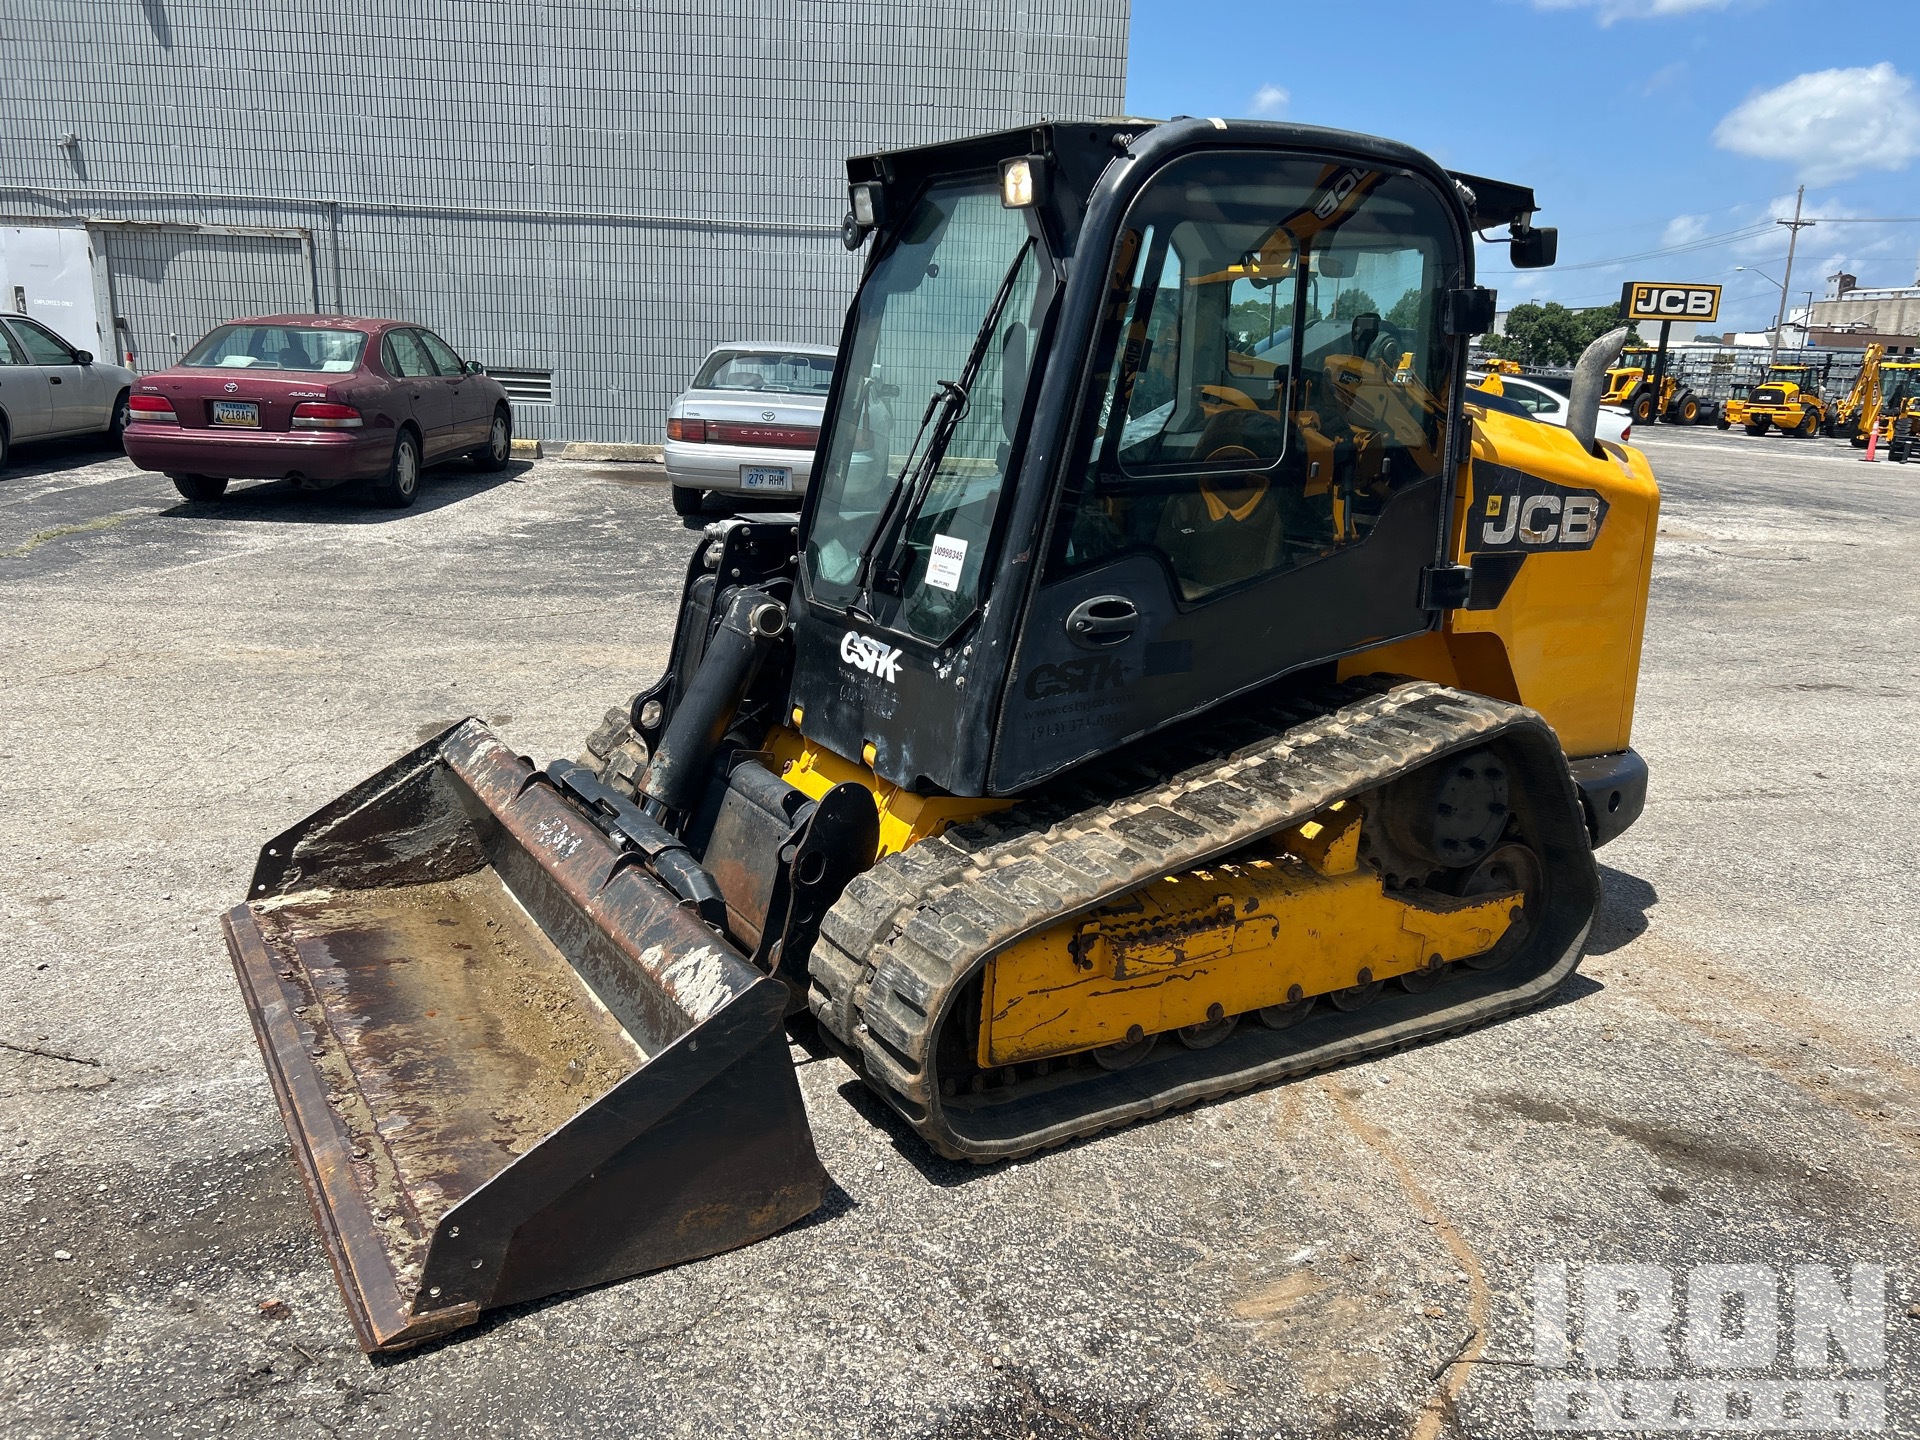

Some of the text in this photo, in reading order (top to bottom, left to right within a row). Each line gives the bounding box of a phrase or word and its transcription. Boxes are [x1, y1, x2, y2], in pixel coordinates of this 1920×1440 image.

[33, 298, 60, 306] EMPLOYEES
[1636, 289, 1713, 314] JCB
[220, 408, 256, 421] 7218AFW
[740, 429, 796, 438] CAMRY
[748, 473, 764, 485] 279
[1482, 495, 1600, 545] JCB
[841, 630, 904, 684] CSTK
[1024, 654, 1134, 701] CSTK
